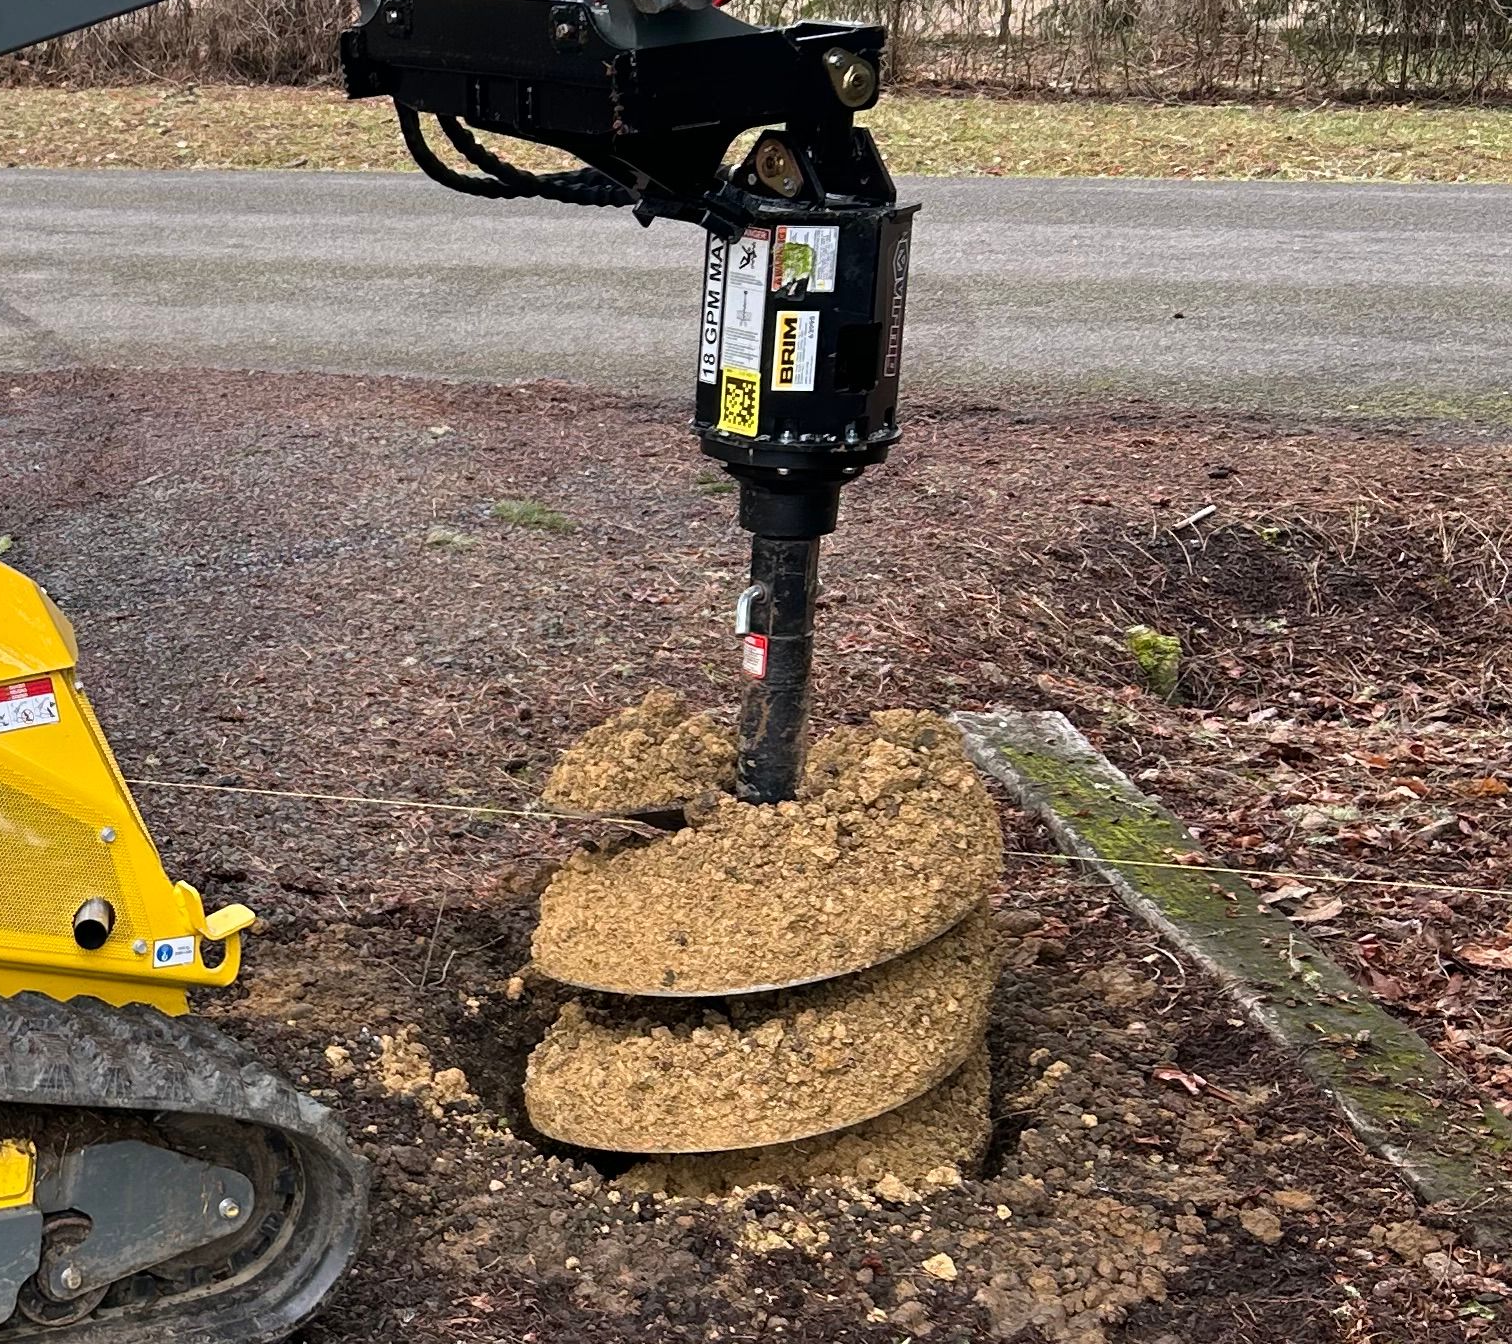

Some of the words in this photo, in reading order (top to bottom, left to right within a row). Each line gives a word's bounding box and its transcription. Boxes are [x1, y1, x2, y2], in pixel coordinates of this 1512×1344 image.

[704, 291, 720, 344] GPM
[701, 353, 716, 379] 18
[779, 317, 798, 384] BRIM
